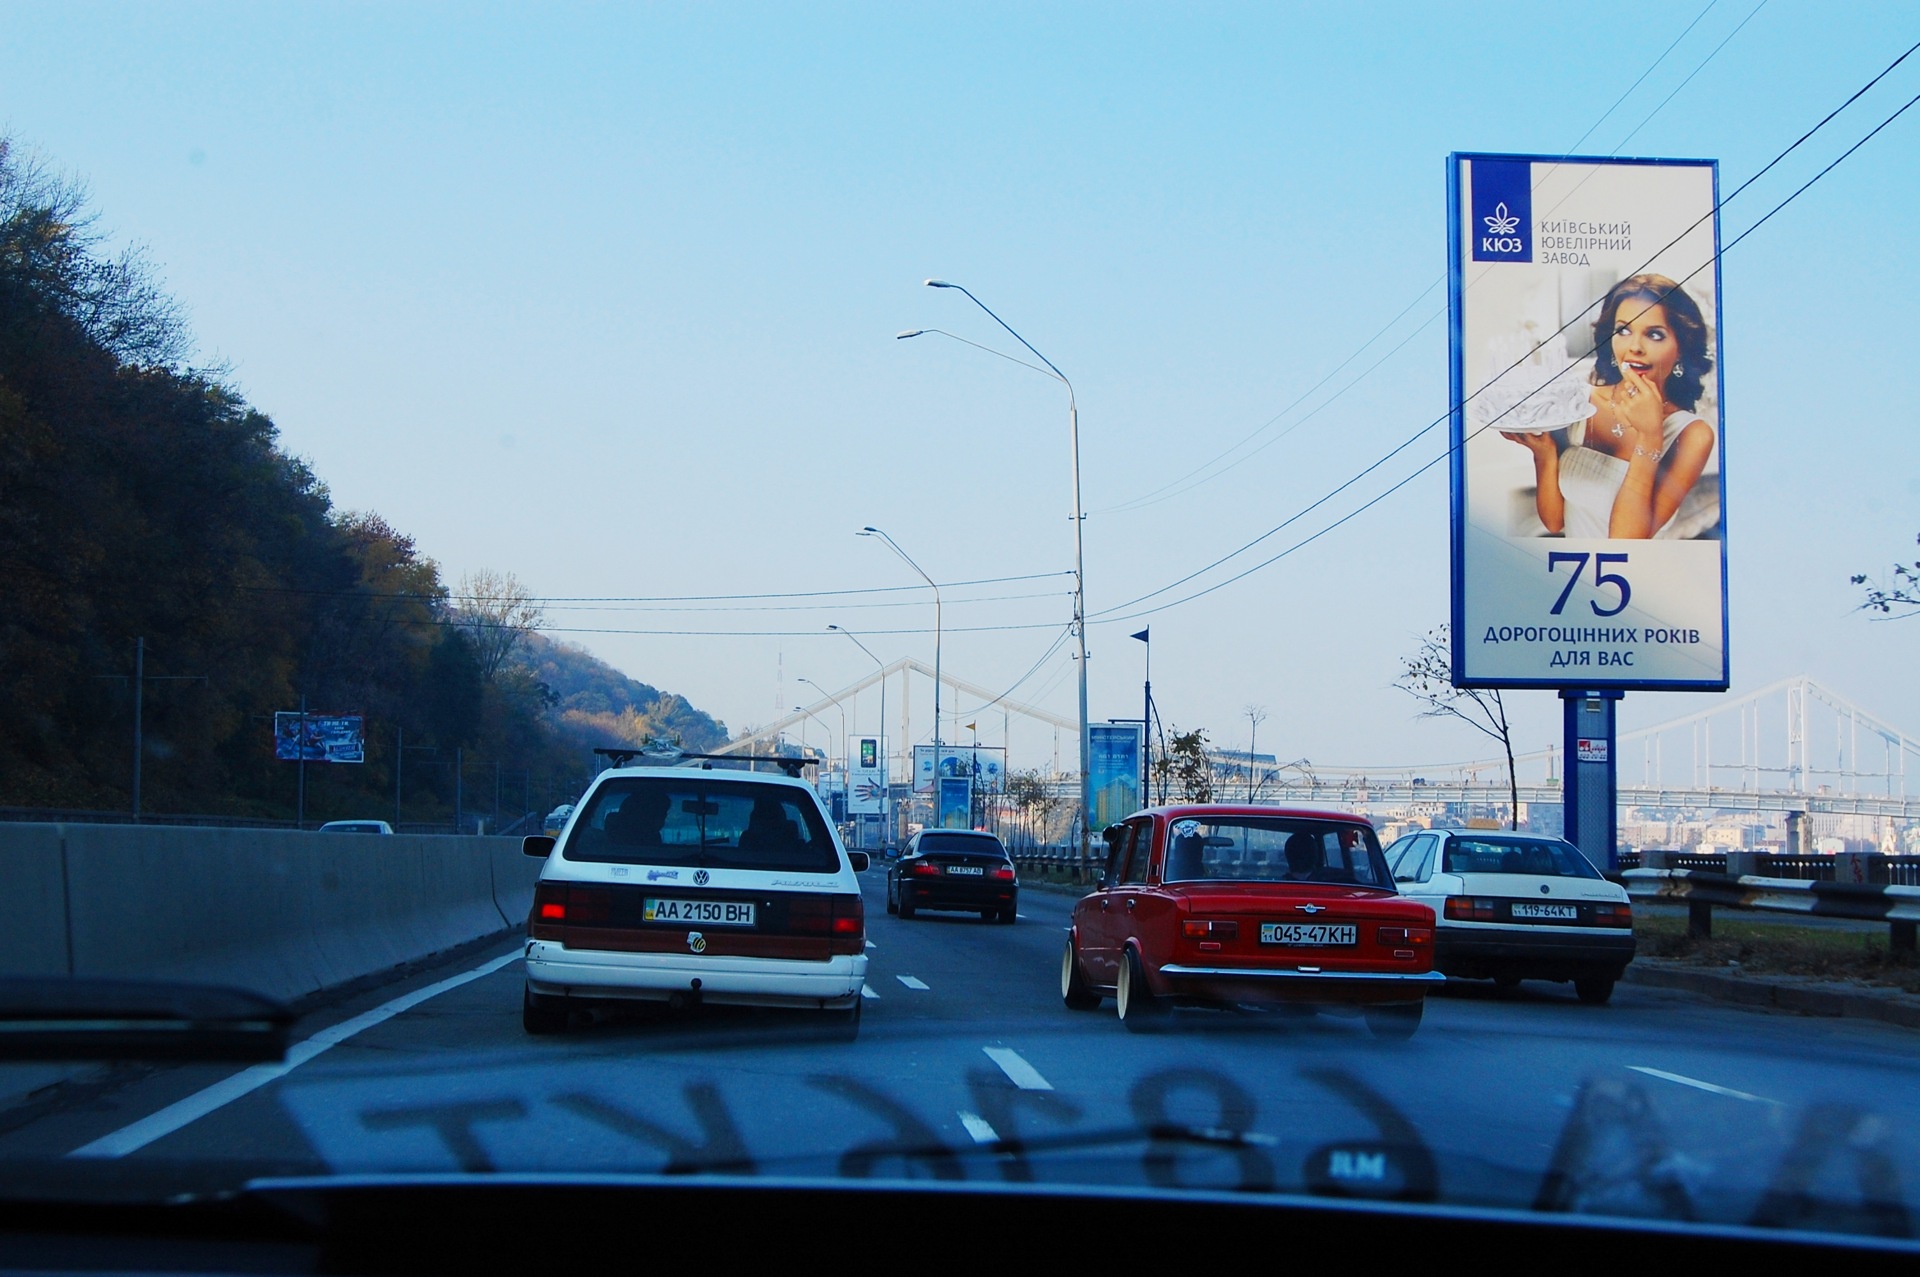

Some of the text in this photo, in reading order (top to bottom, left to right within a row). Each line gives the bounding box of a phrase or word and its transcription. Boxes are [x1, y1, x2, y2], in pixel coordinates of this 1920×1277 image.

[1541, 219, 1631, 235] КИЇВСЬКИЙ
[1482, 237, 1522, 253] КЮЗ
[1541, 236, 1631, 251] ЮВЕЛІРНИЙ
[1541, 252, 1590, 267] ЗАВОД
[1548, 552, 1631, 617] 75
[1483, 626, 1700, 644] ДОРОГОЦІННИХ РОКІВ
[1550, 651, 1634, 667] ДЛЯ ВАС
[655, 901, 750, 922] AA 2150 BH
